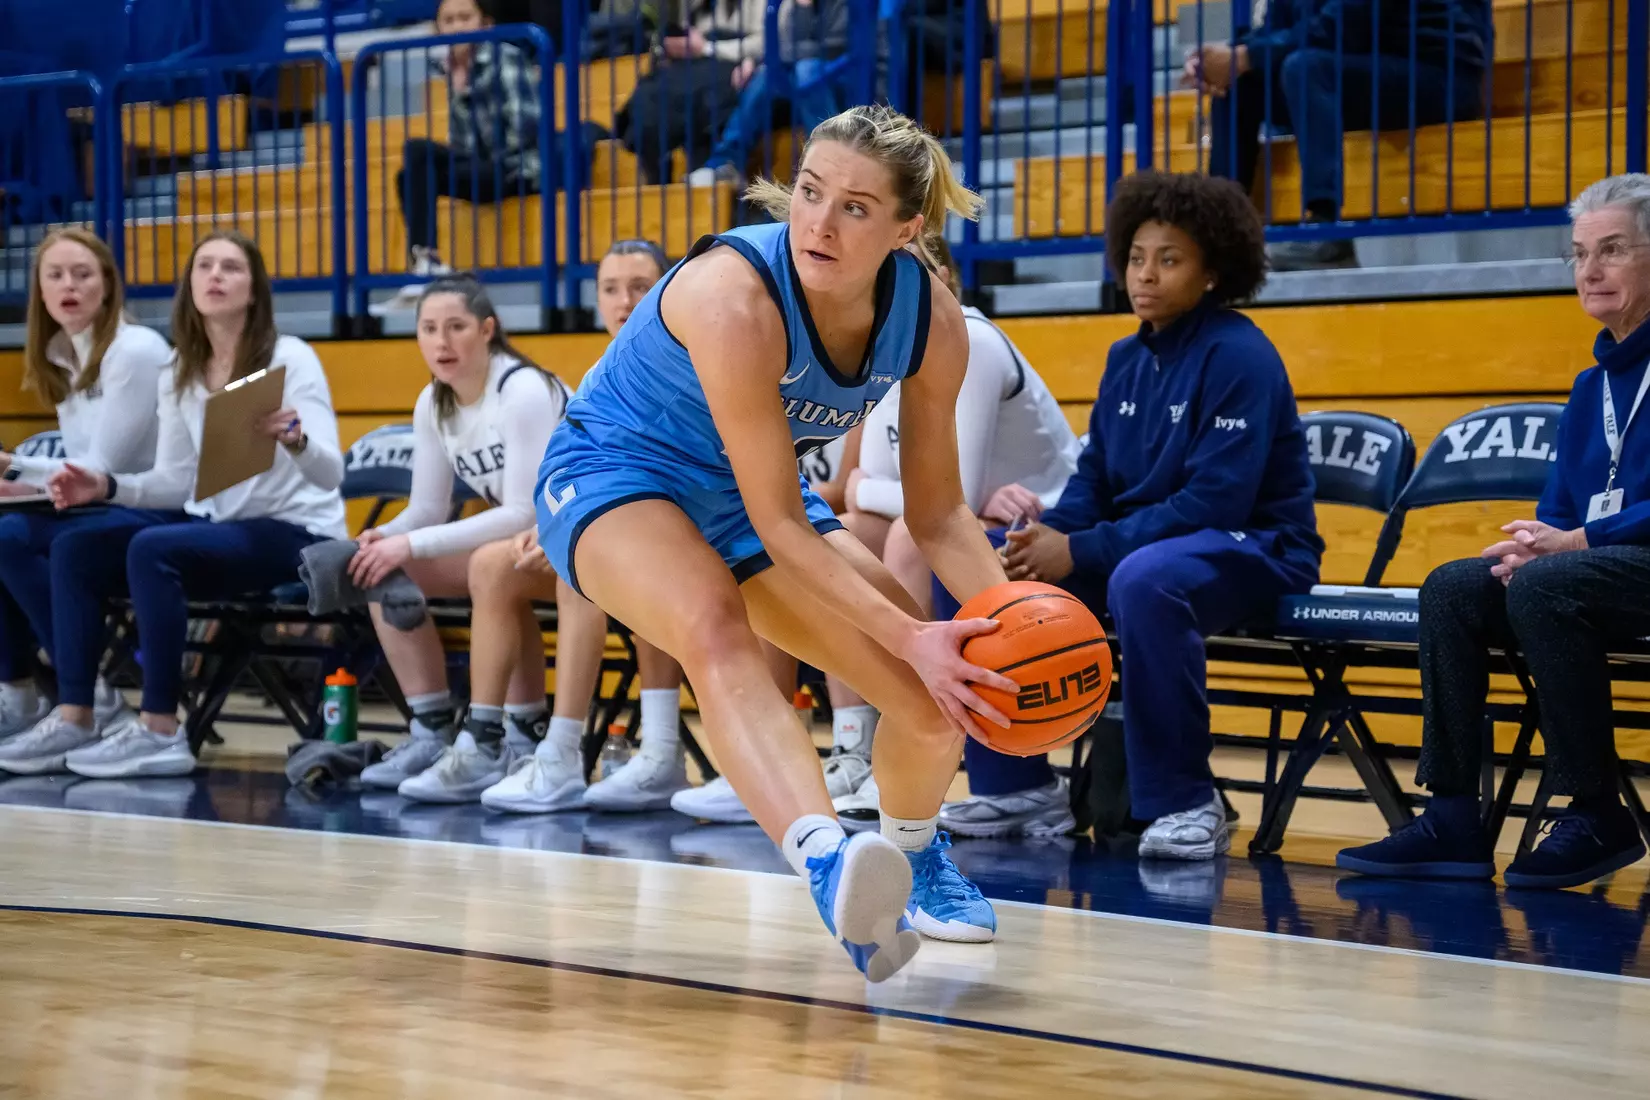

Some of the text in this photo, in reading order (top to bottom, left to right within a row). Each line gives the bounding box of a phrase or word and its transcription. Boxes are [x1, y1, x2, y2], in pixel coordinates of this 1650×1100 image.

[455, 443, 504, 477] ALE
[1306, 425, 1392, 476] ALE
[1444, 416, 1557, 463] YAL
[1311, 608, 1359, 620] UNDER
[1016, 661, 1101, 711] ELITE
